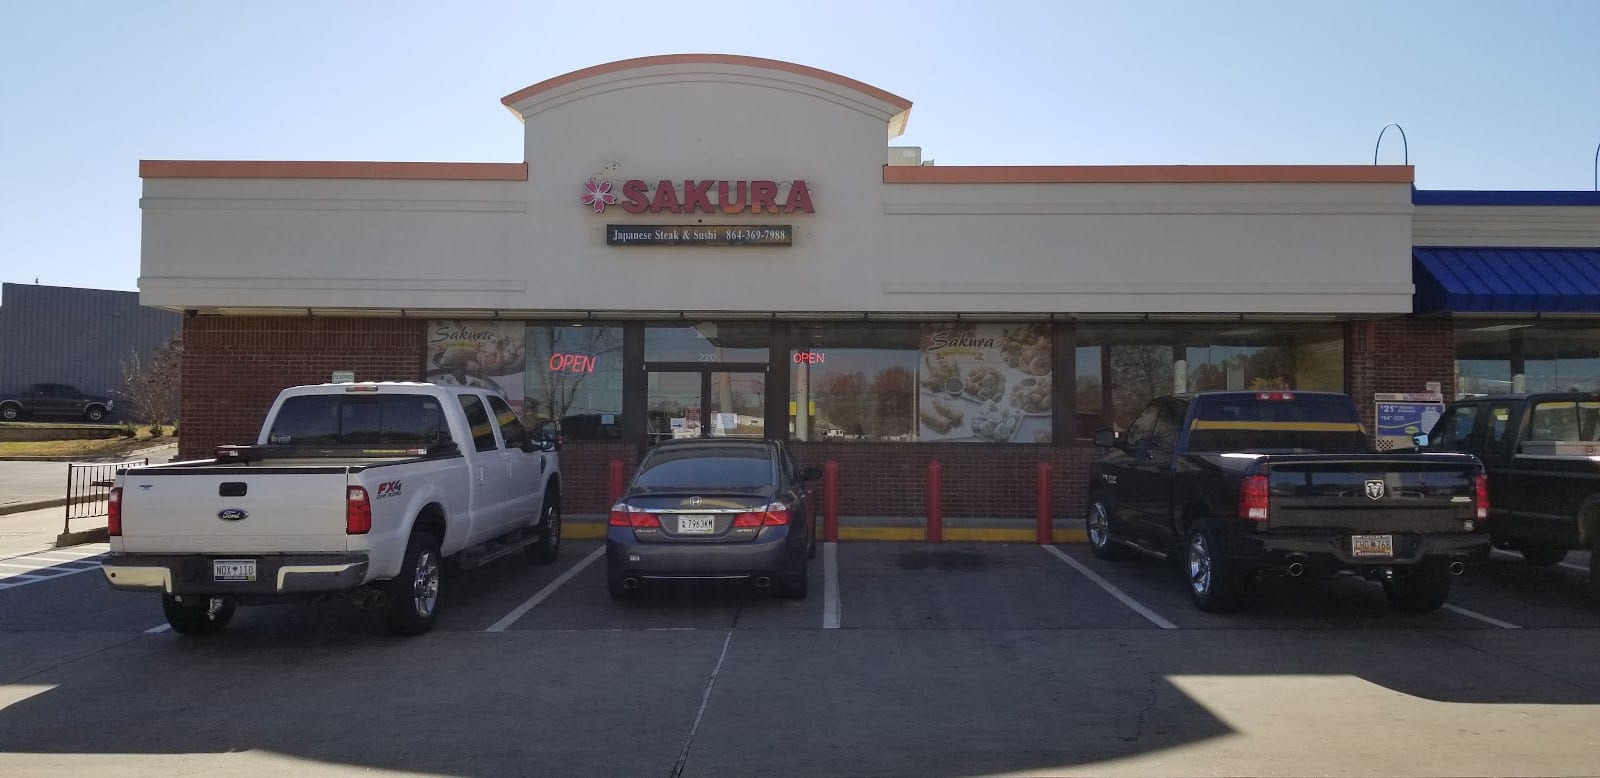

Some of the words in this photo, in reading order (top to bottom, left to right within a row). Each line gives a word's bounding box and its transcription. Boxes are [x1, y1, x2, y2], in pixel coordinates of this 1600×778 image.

[622, 180, 815, 214] SAKURA
[613, 229, 652, 242] Japanese
[655, 229, 679, 240] Steak
[683, 230, 690, 240] &
[693, 229, 717, 240] Sushi
[726, 229, 786, 240] 864-369-7988
[429, 326, 495, 343] Sakura
[928, 332, 994, 351] Sakura
[549, 352, 597, 373] OPEN
[698, 353, 717, 361] 220
[793, 352, 825, 364] OPEN
[378, 480, 402, 494] FX4
